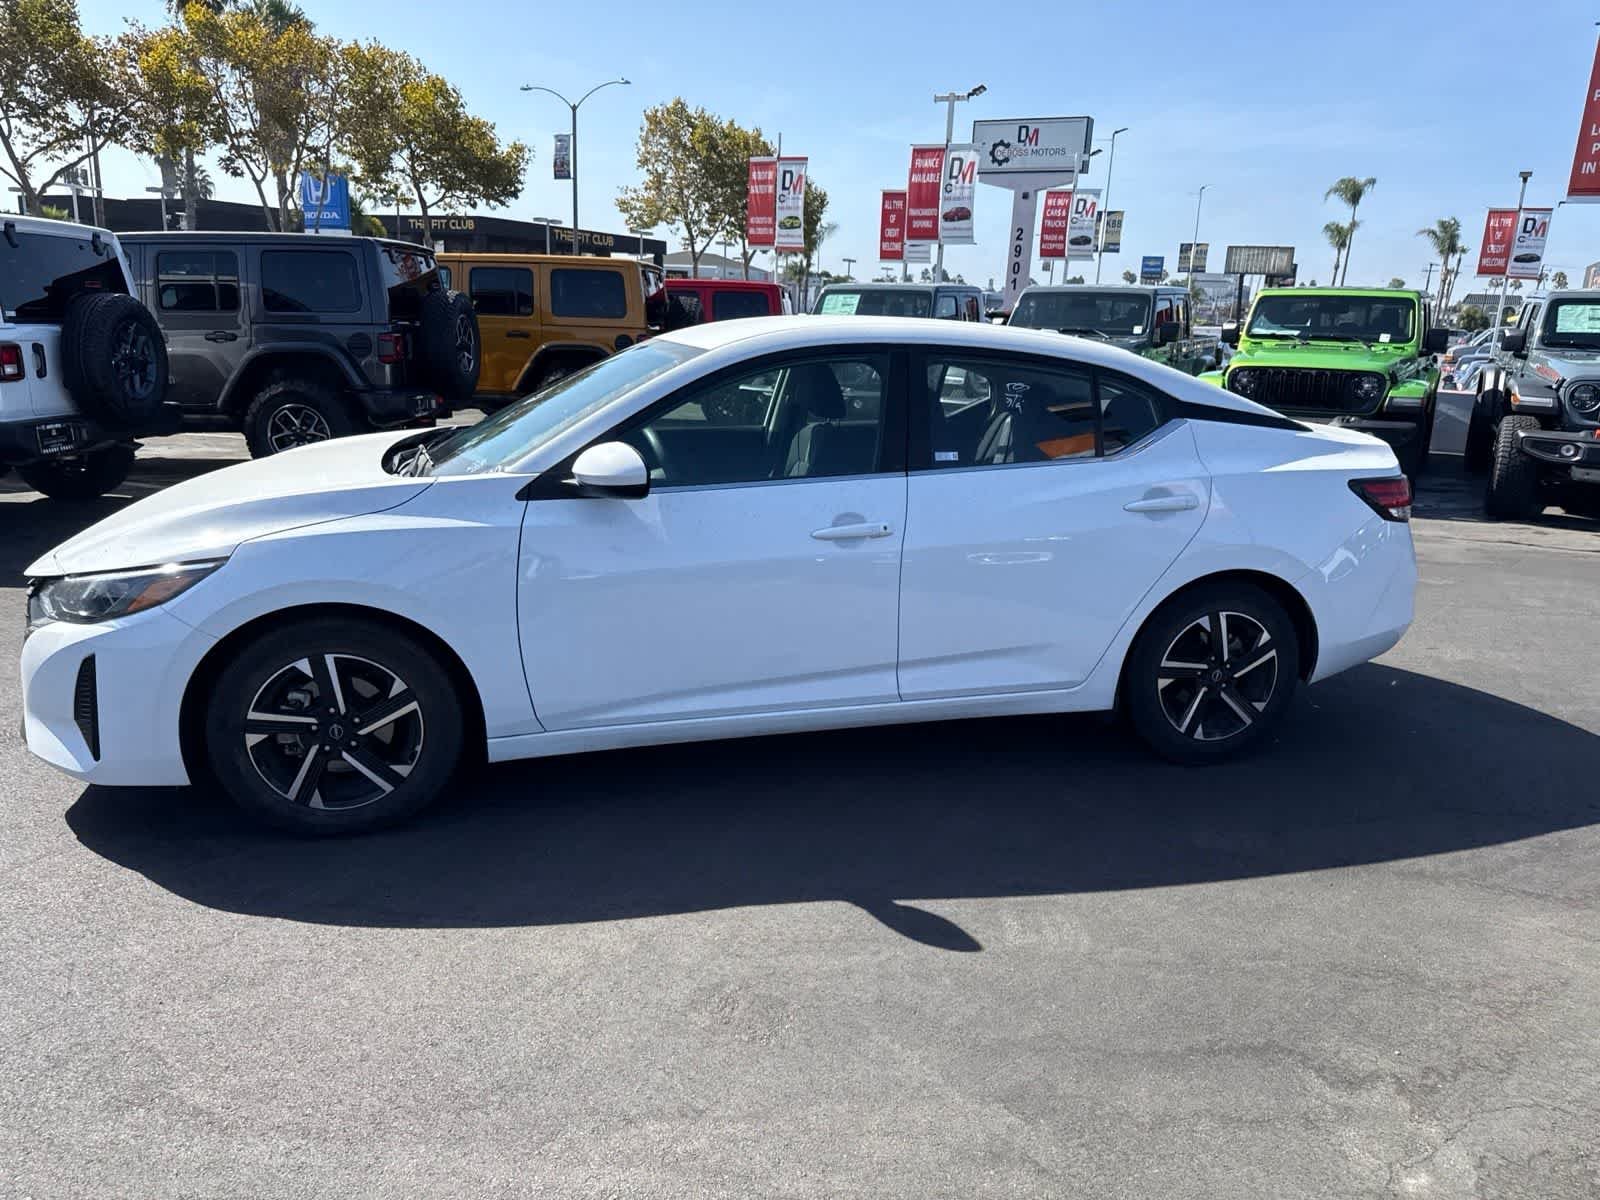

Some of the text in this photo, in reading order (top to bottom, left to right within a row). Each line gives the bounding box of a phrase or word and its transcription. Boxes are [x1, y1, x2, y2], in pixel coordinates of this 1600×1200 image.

[1018, 125, 1040, 147] DM
[1030, 147, 1067, 157] MOTORS
[915, 158, 941, 168] FINANCE
[1581, 161, 1597, 175] IN
[911, 172, 941, 183] AVAILABLE
[431, 218, 448, 230] FIT
[448, 218, 476, 231] CLUB
[553, 229, 574, 242] THE
[591, 233, 614, 247] CLUB
[1010, 227, 1024, 291] 2901
